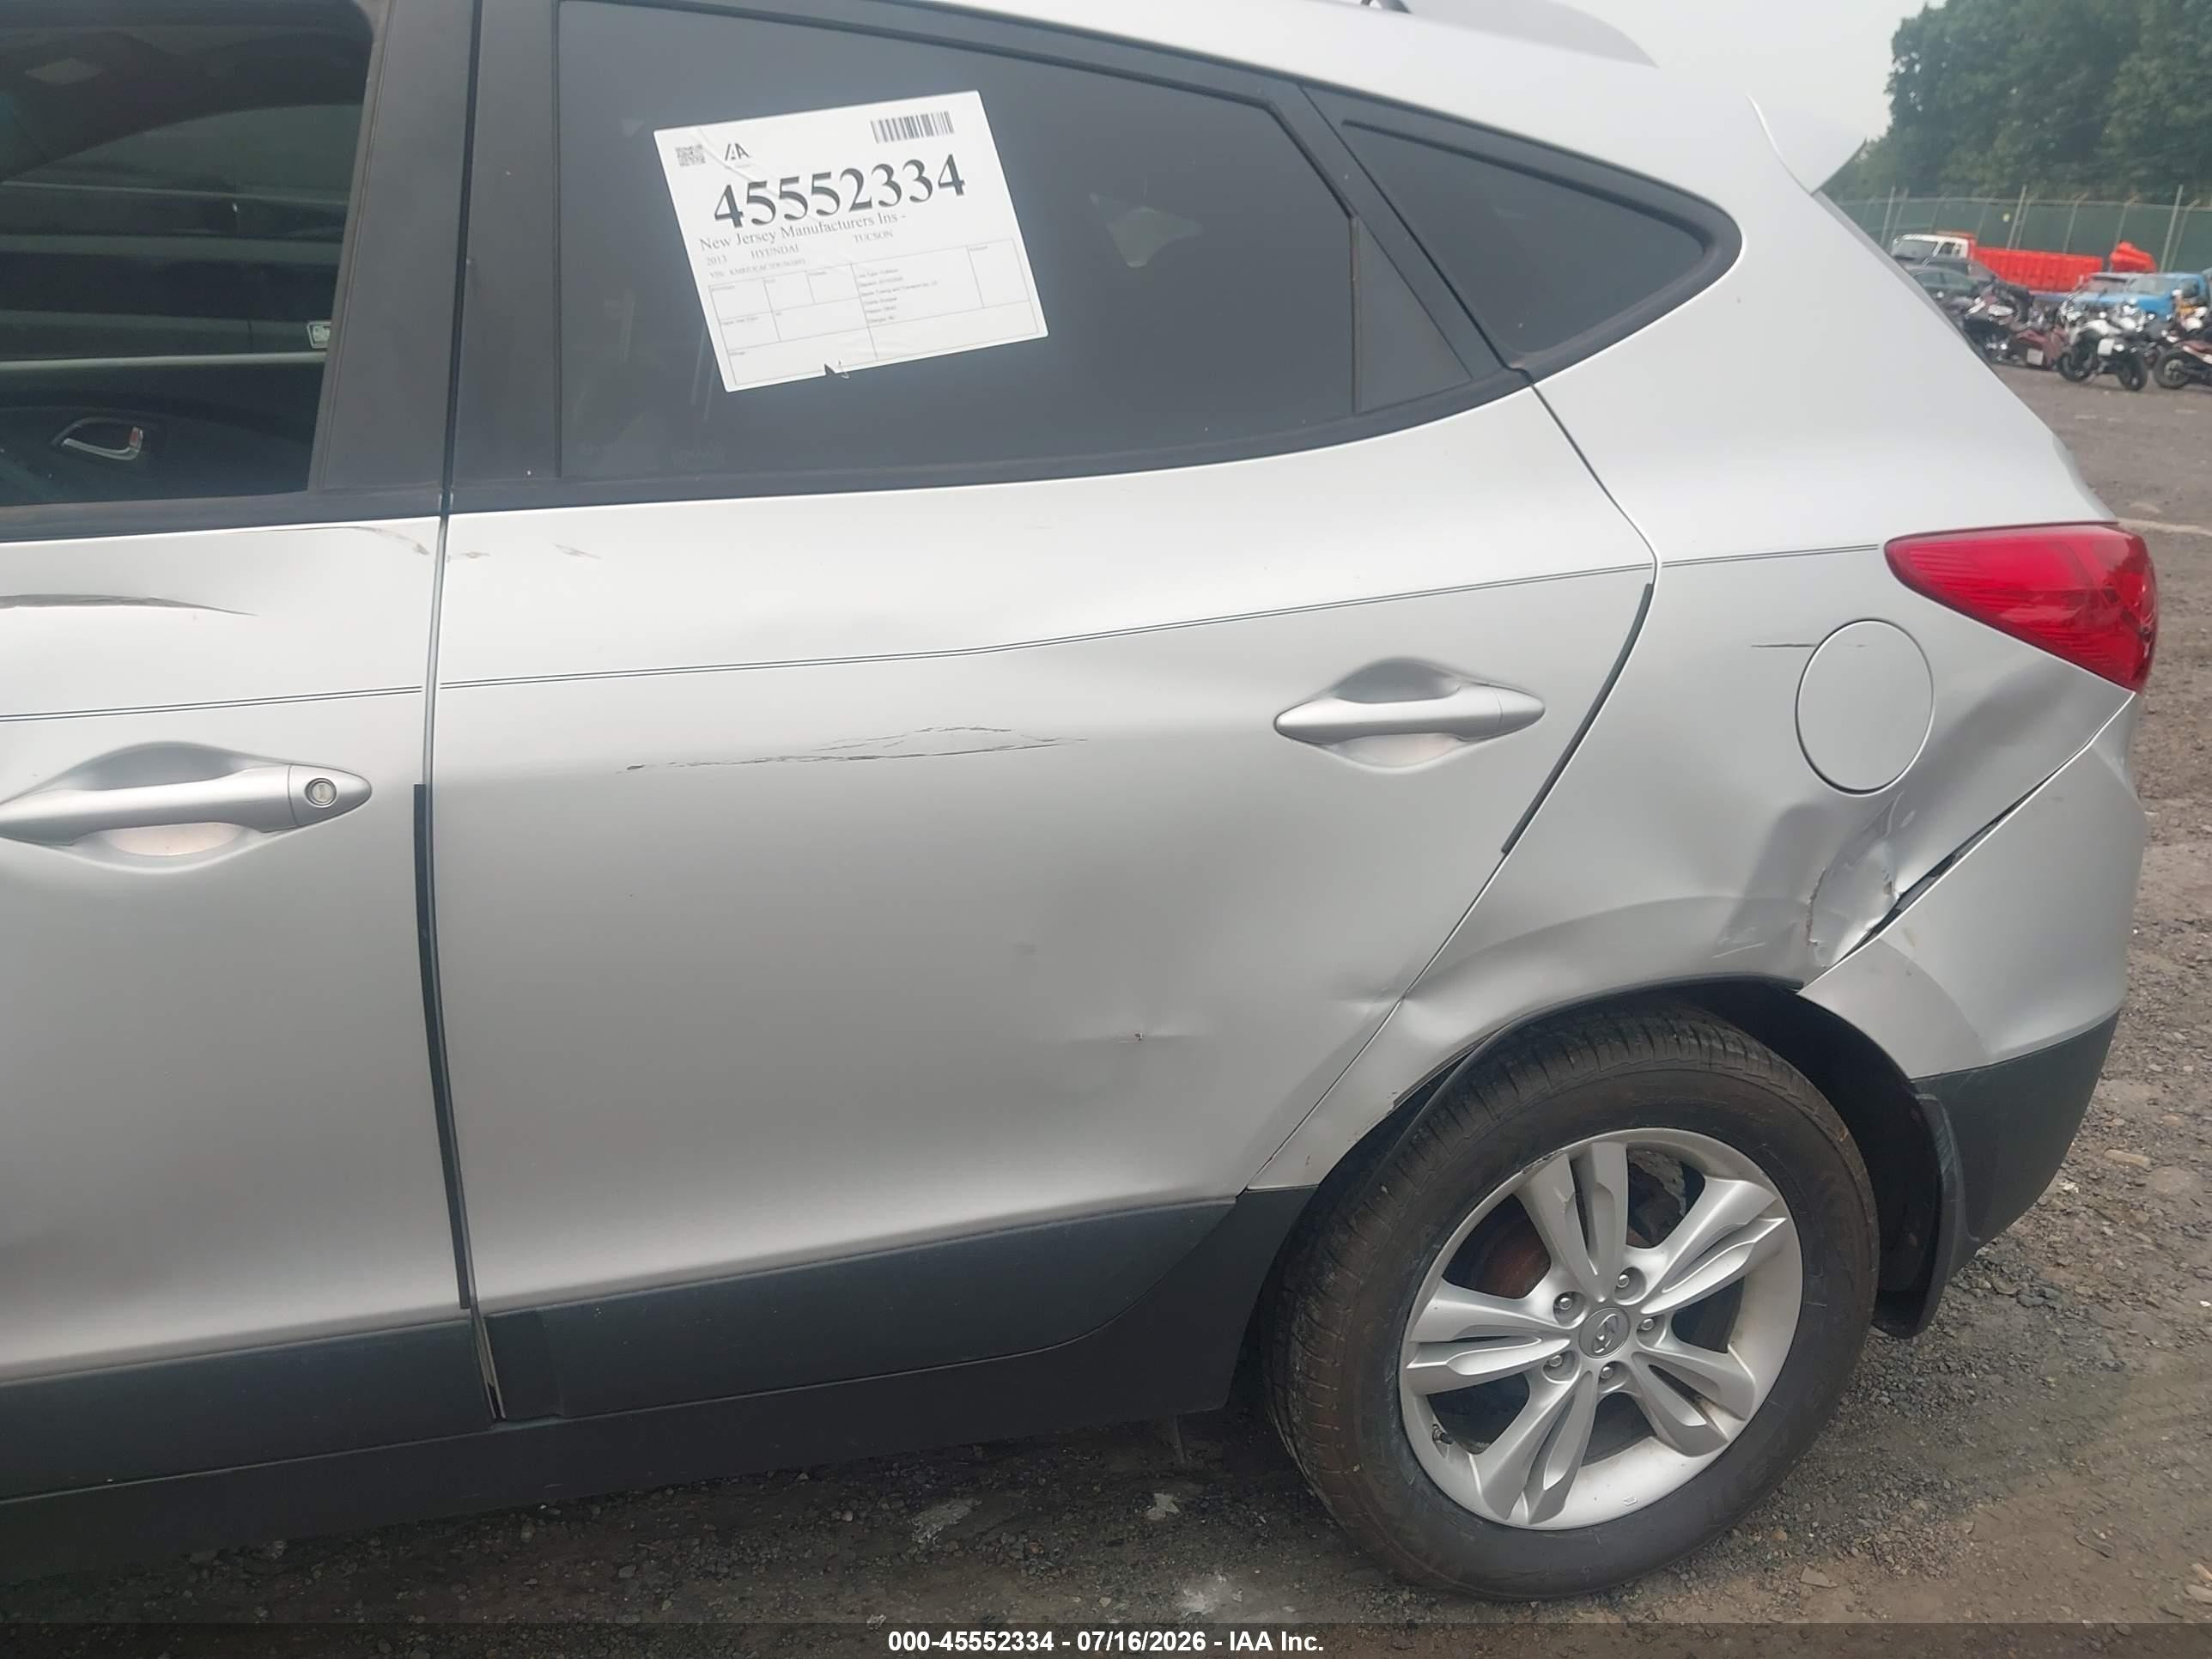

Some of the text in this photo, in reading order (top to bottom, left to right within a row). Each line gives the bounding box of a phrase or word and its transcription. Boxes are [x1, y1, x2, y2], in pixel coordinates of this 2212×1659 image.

[714, 154, 965, 228] 45552334
[700, 237, 731, 252] New
[736, 232, 775, 246] Jersey
[780, 216, 875, 239] Manufacturers
[878, 212, 898, 225] Ins
[707, 230, 893, 266] 2013 HYUNDAI TUCSON
